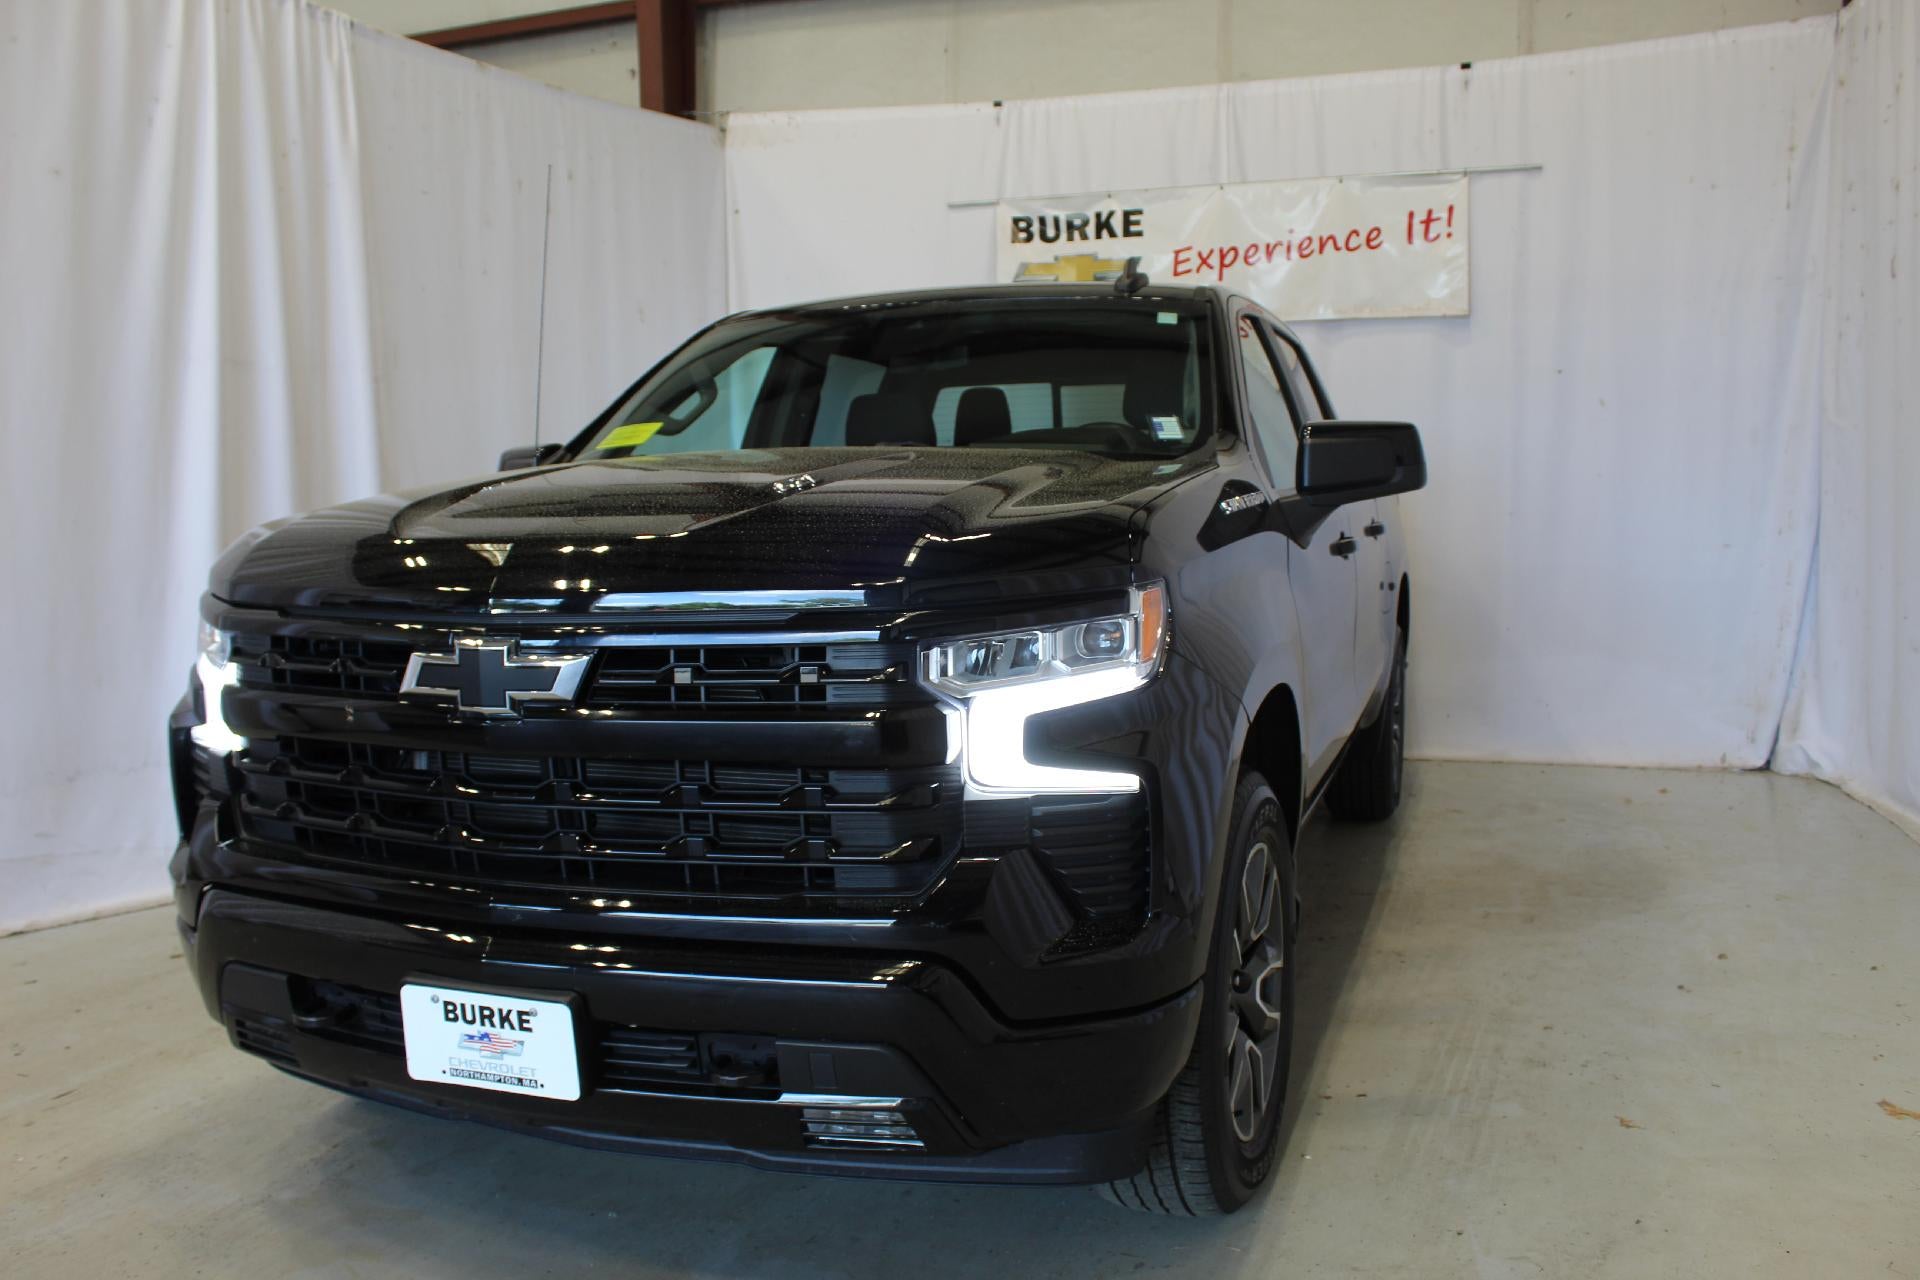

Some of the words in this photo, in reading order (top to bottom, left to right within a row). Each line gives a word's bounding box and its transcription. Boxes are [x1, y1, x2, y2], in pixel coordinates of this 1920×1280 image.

[1011, 208, 1144, 244] BURKE
[1172, 224, 1384, 282] Experience
[1406, 204, 1455, 246] It!
[443, 1000, 533, 1033] BURKE
[448, 1056, 537, 1077] CHEVROLET
